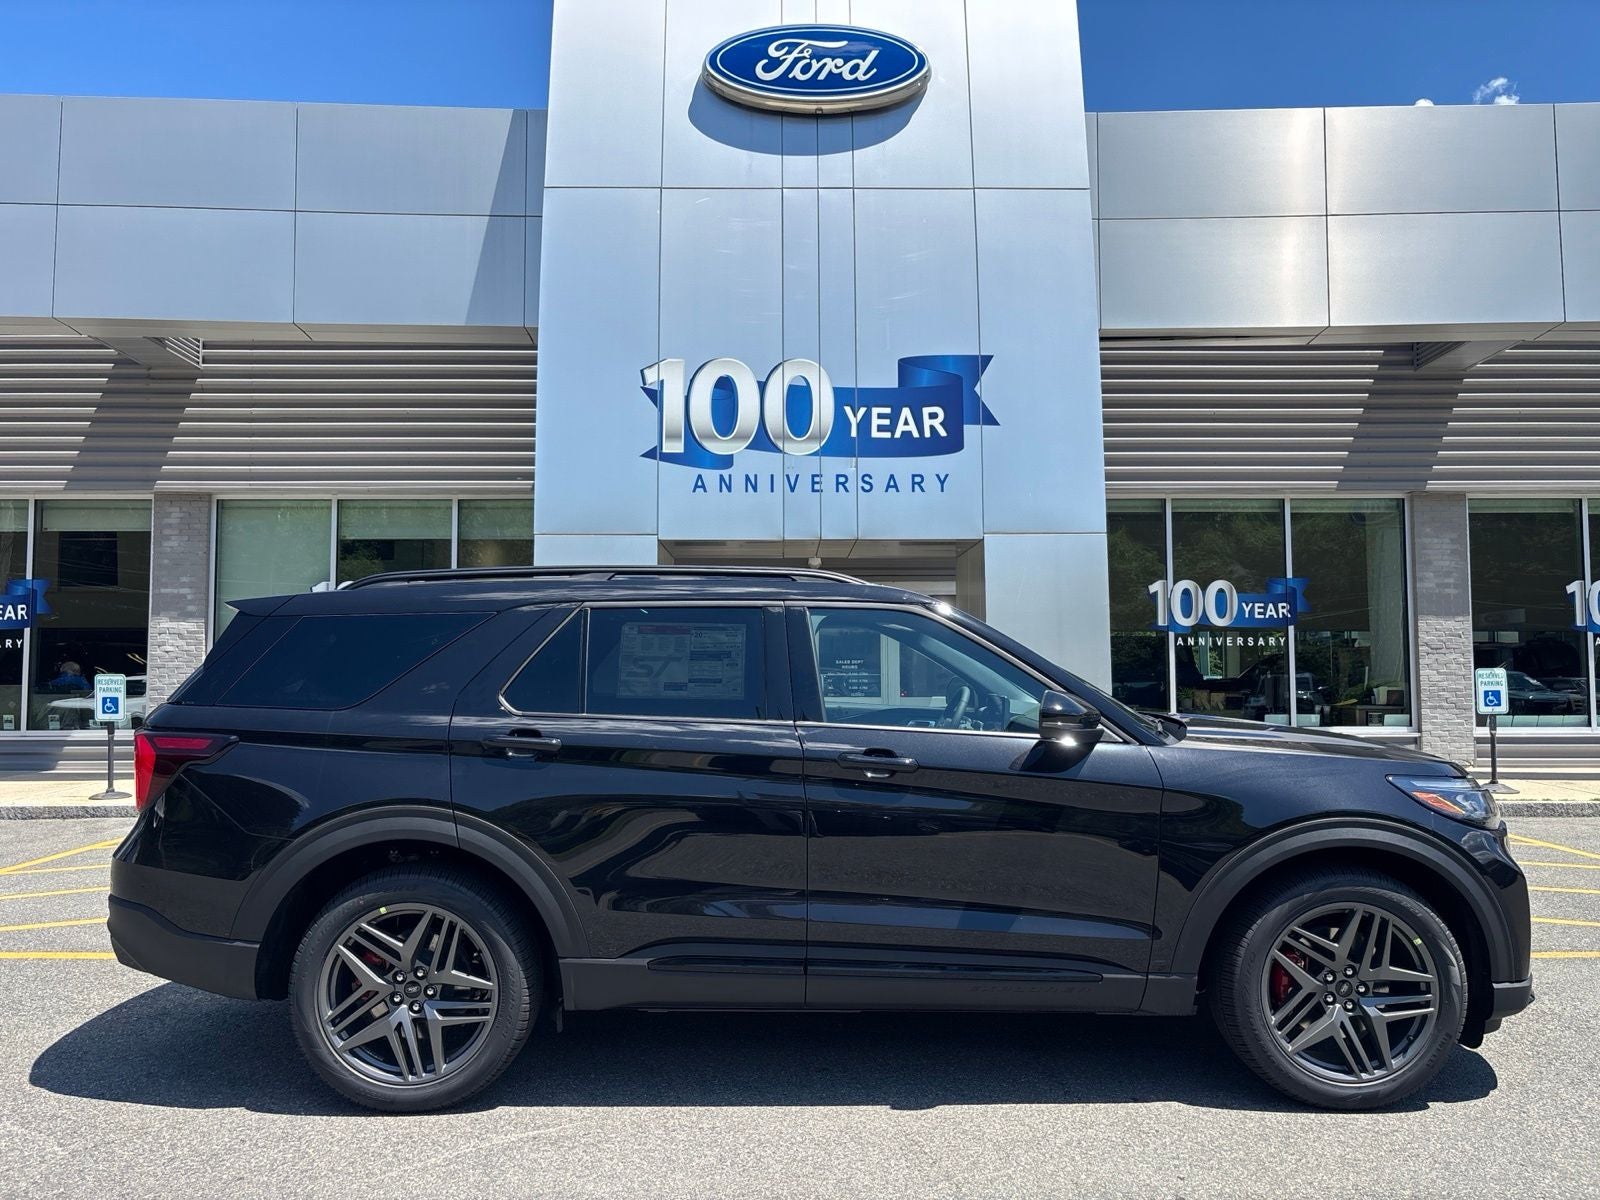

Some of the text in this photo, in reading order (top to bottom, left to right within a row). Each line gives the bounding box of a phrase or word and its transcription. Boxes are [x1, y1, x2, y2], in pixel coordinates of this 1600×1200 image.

[755, 38, 880, 81] Ford
[640, 357, 948, 456] 100 YEAR
[692, 473, 950, 493] ANNIVERSARY
[1148, 579, 1291, 627] 100 YEAR
[1176, 636, 1286, 646] ANNIVERSARY
[97, 678, 124, 686] RESERVED
